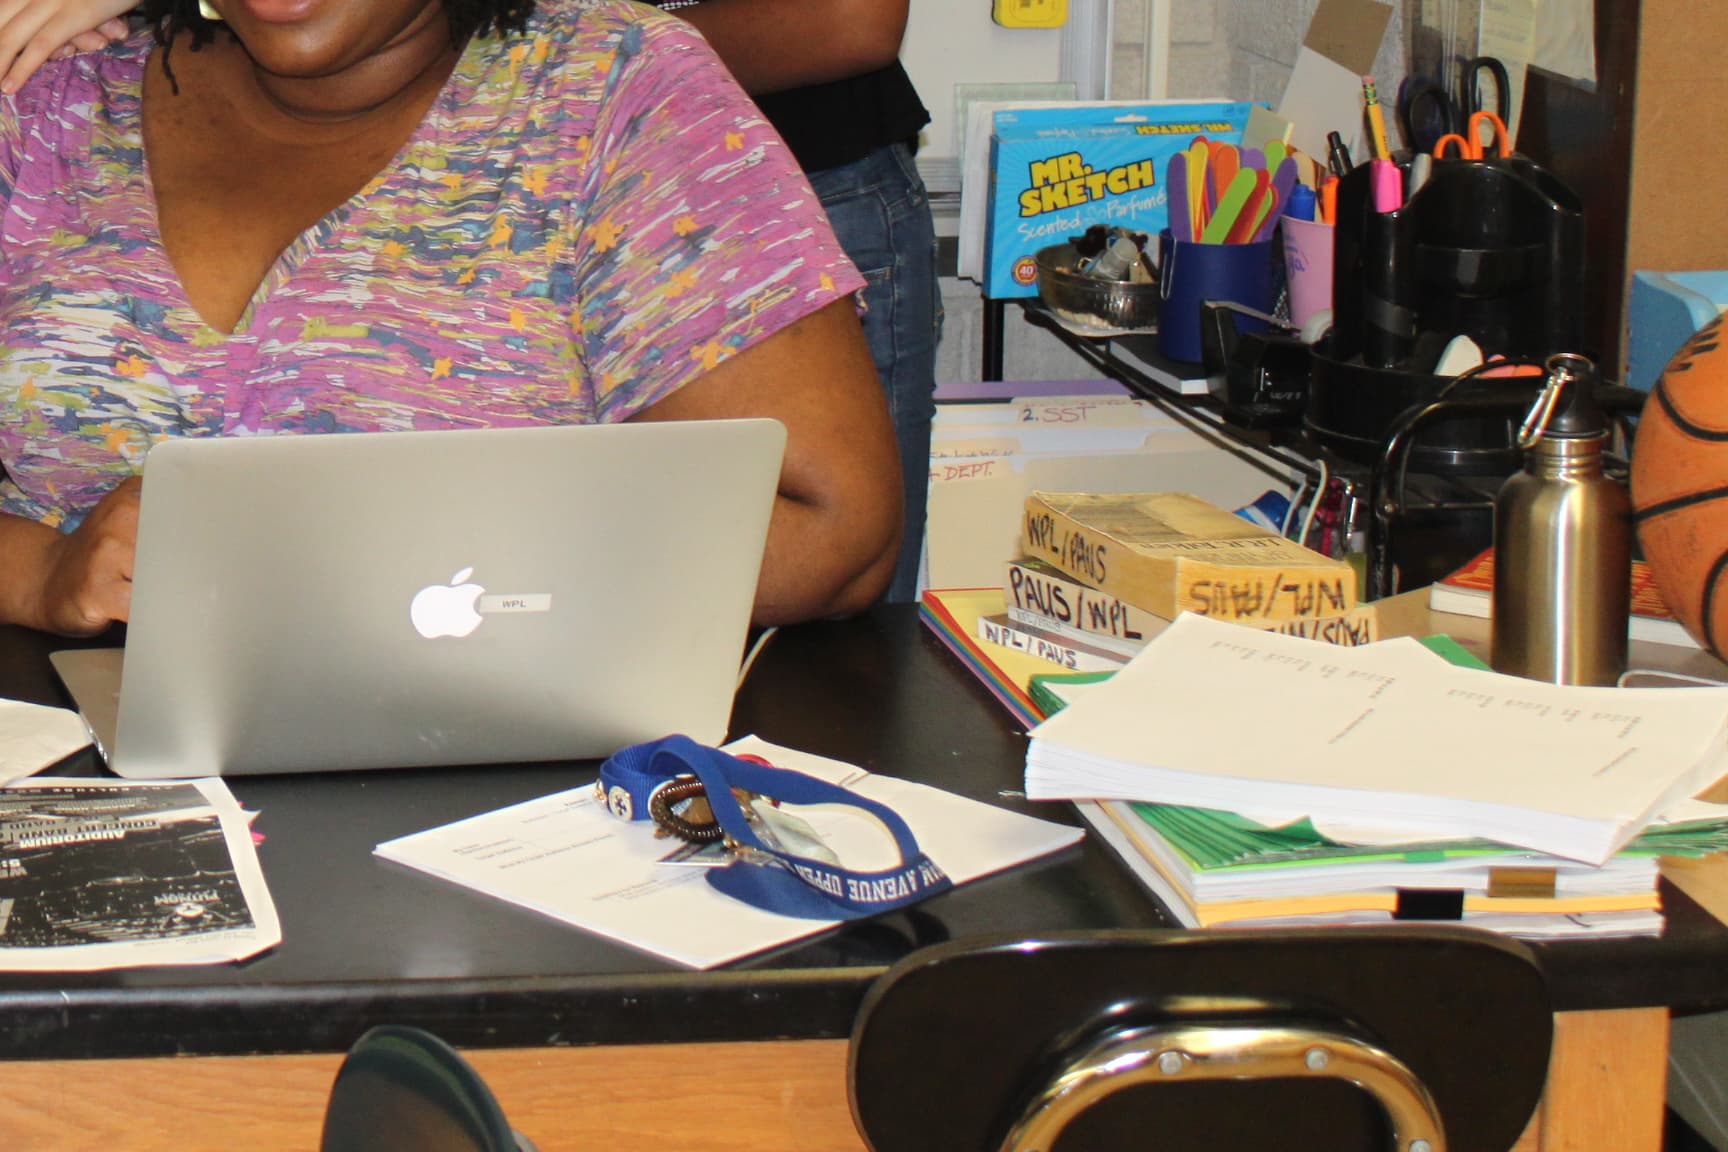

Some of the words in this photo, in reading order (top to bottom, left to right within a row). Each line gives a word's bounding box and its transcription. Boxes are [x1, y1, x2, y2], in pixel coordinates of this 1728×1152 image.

[1028, 151, 1094, 188] MR.
[1017, 158, 1156, 218] SKETCH
[943, 460, 996, 481] DEPT.
[501, 599, 527, 609] WPL
[19, 829, 126, 849] AUDITORIUM
[793, 863, 844, 897] UPPER
[846, 869, 918, 902] AVENUE
